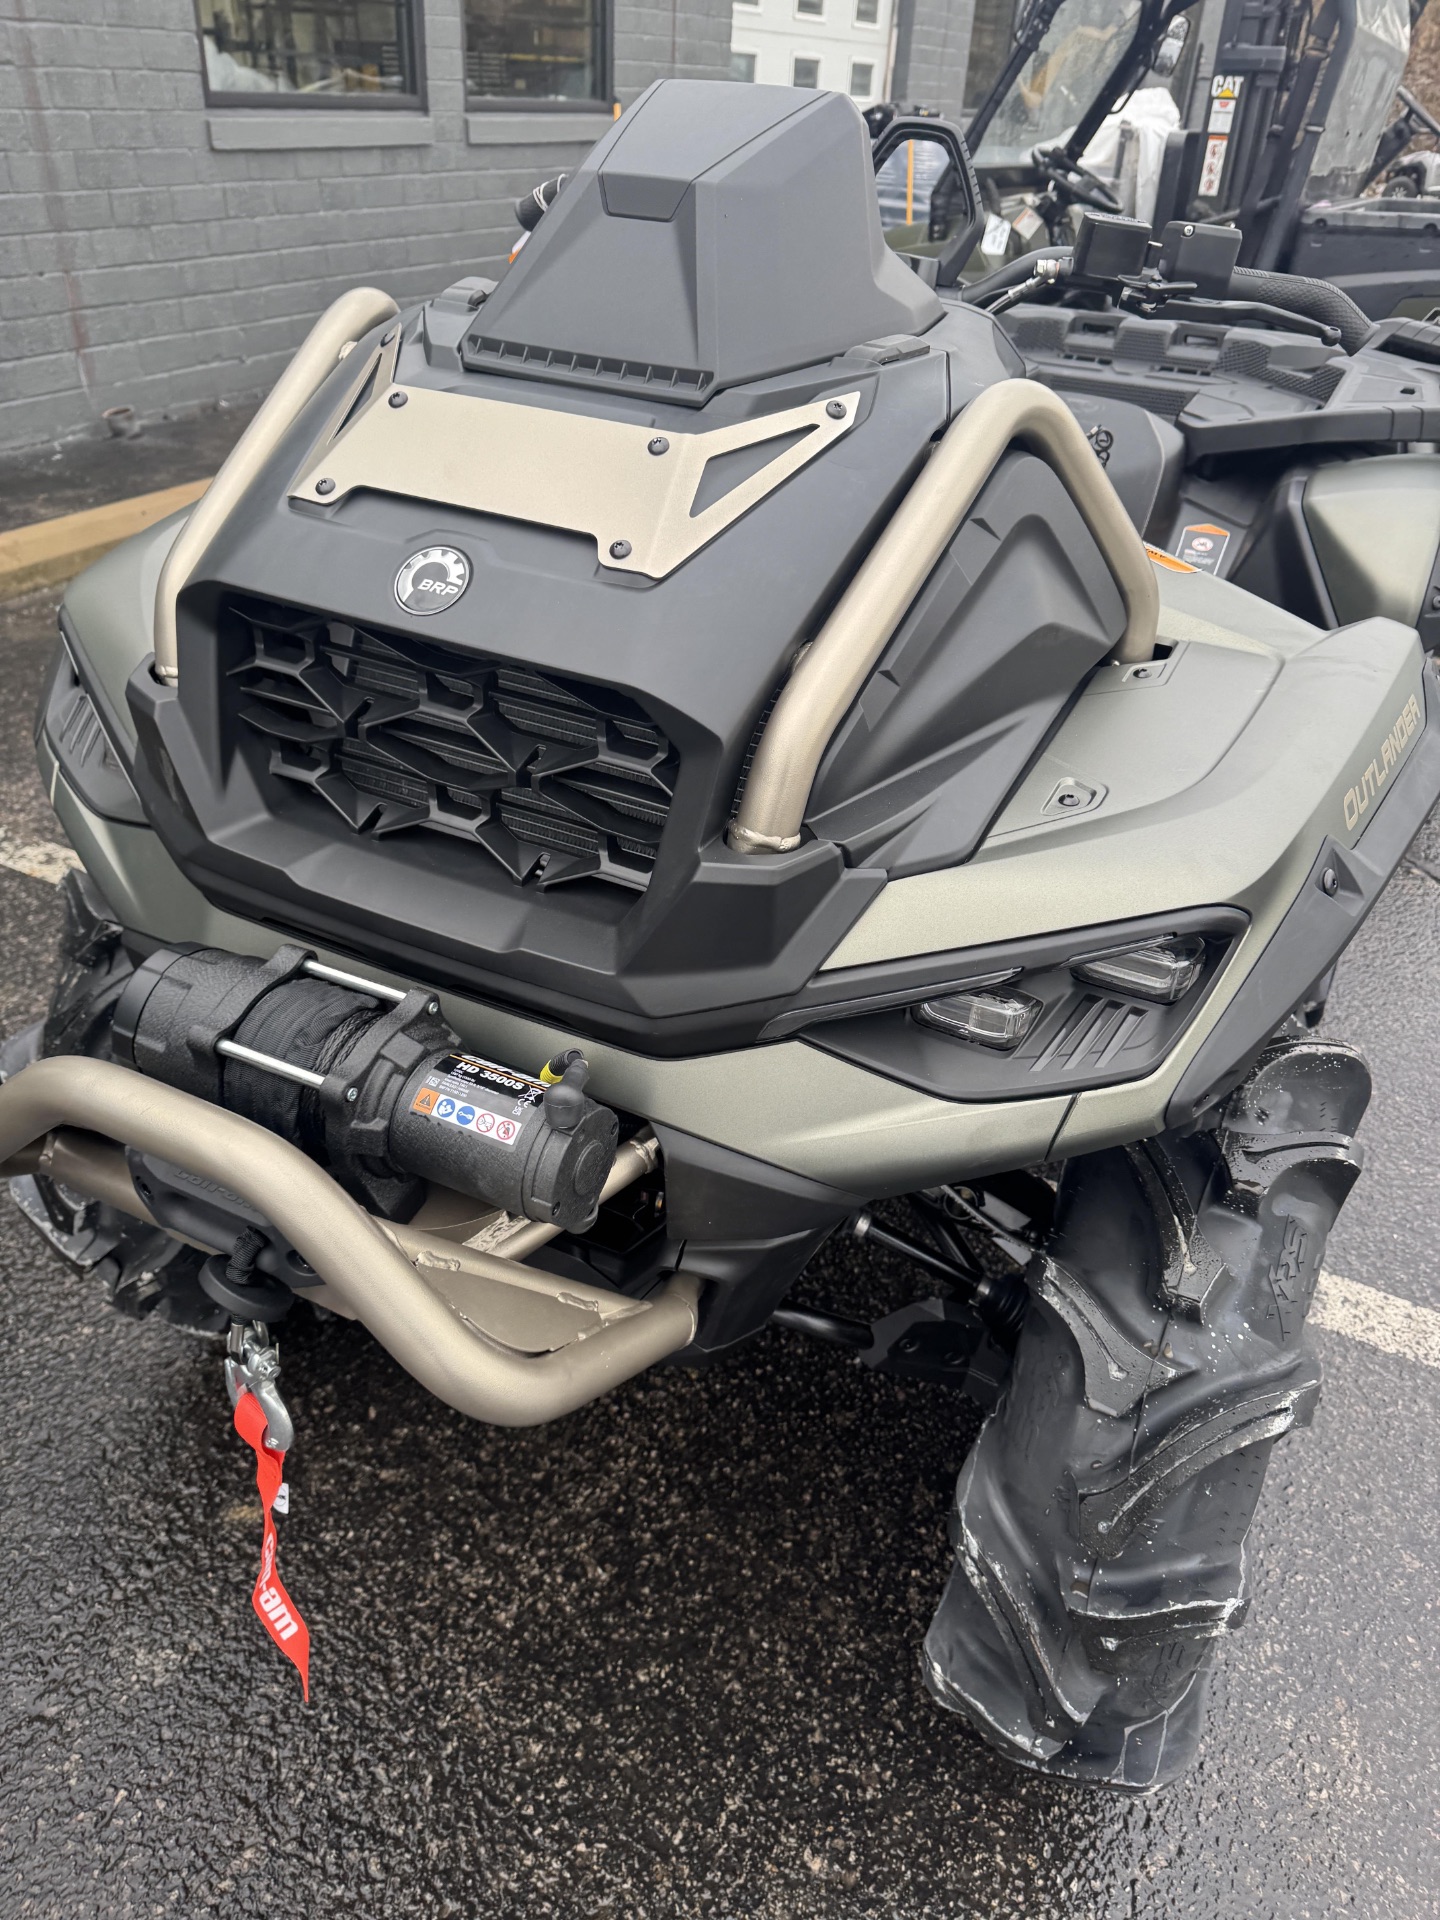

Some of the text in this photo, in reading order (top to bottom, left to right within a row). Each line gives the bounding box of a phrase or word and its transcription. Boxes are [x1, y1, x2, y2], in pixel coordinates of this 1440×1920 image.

[1211, 75, 1244, 98] CAT
[417, 578, 459, 596] BRP
[1343, 694, 1421, 831] OUTLANDER
[456, 1061, 479, 1075] HD
[480, 1070, 525, 1091] 3500S
